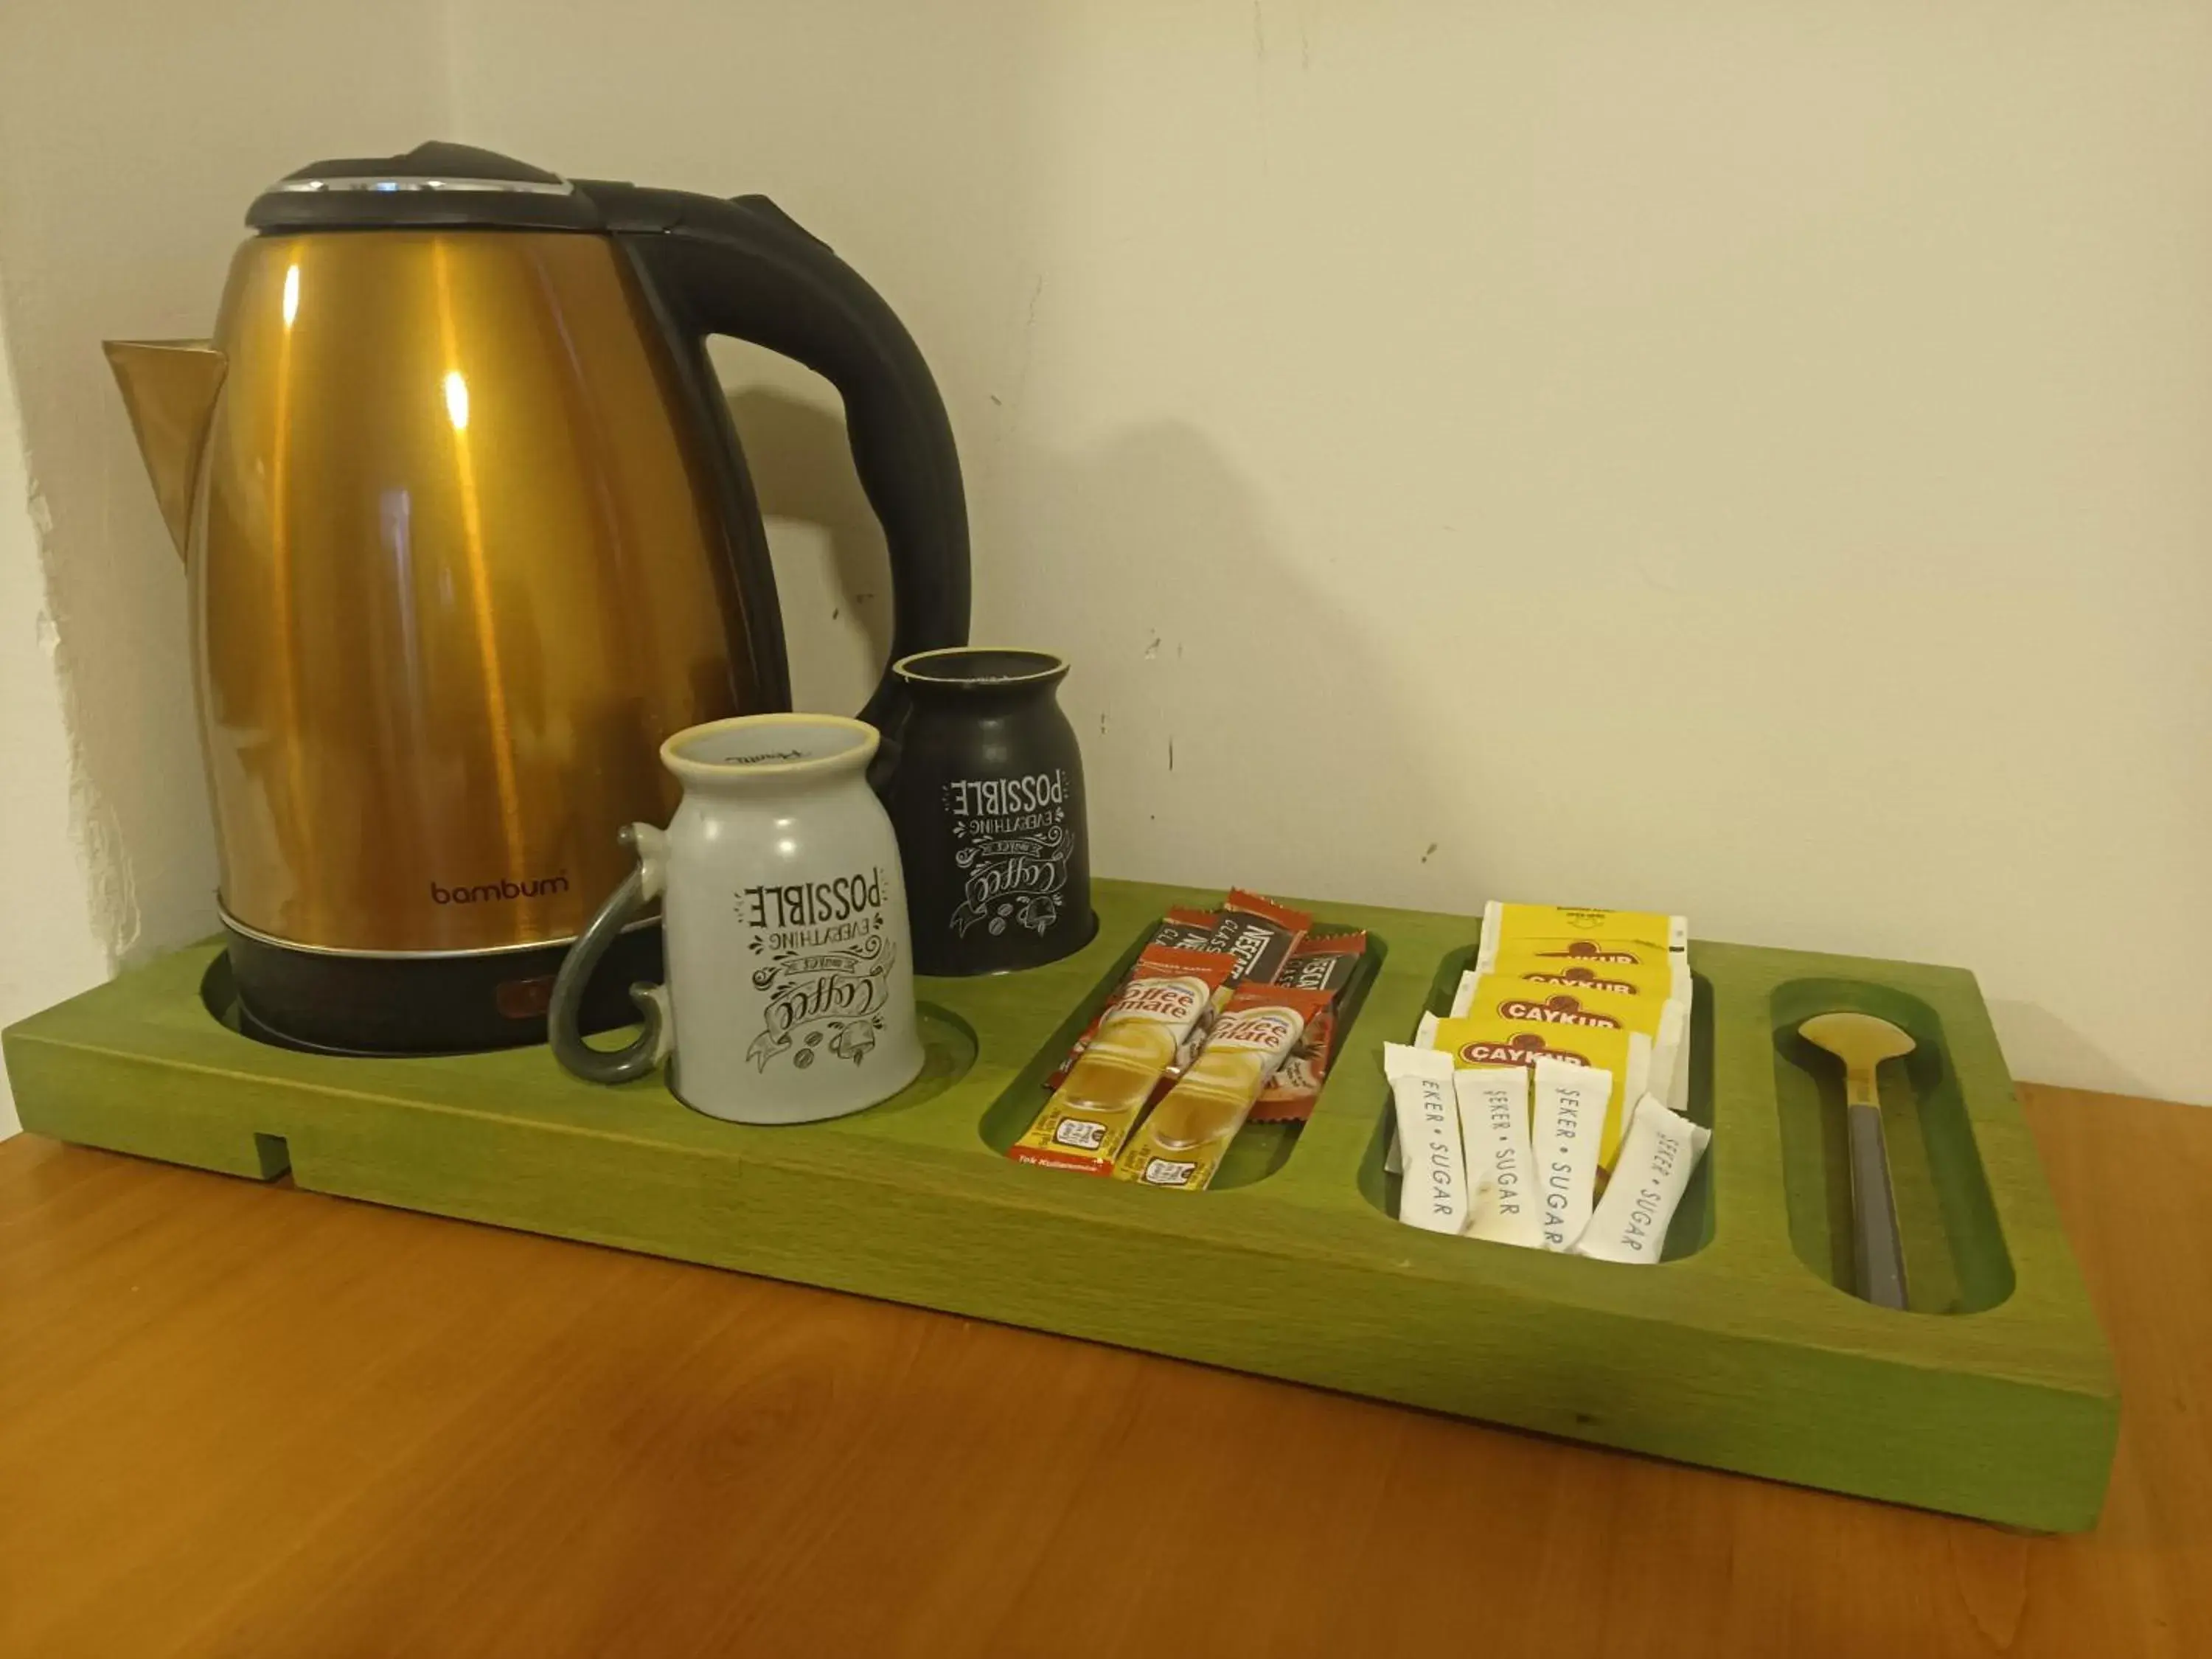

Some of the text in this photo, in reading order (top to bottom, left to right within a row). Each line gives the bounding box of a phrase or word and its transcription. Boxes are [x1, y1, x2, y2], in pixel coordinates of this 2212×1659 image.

[951, 768, 1062, 815] POSSIBLE
[970, 811, 1053, 834] EVERYTHING
[431, 876, 569, 905] bambum
[744, 867, 881, 928] POSSIBLE
[977, 855, 1055, 902] Coffee
[769, 918, 870, 950] EVERYTHING
[779, 974, 874, 1032] Coffee
[1429, 1141, 1453, 1215] SUGAR
[1495, 1148, 1520, 1215] SUGAR
[1544, 1087, 1580, 1245] ŞEKER SUGAR
[1620, 1188, 1662, 1251] SUGAR
